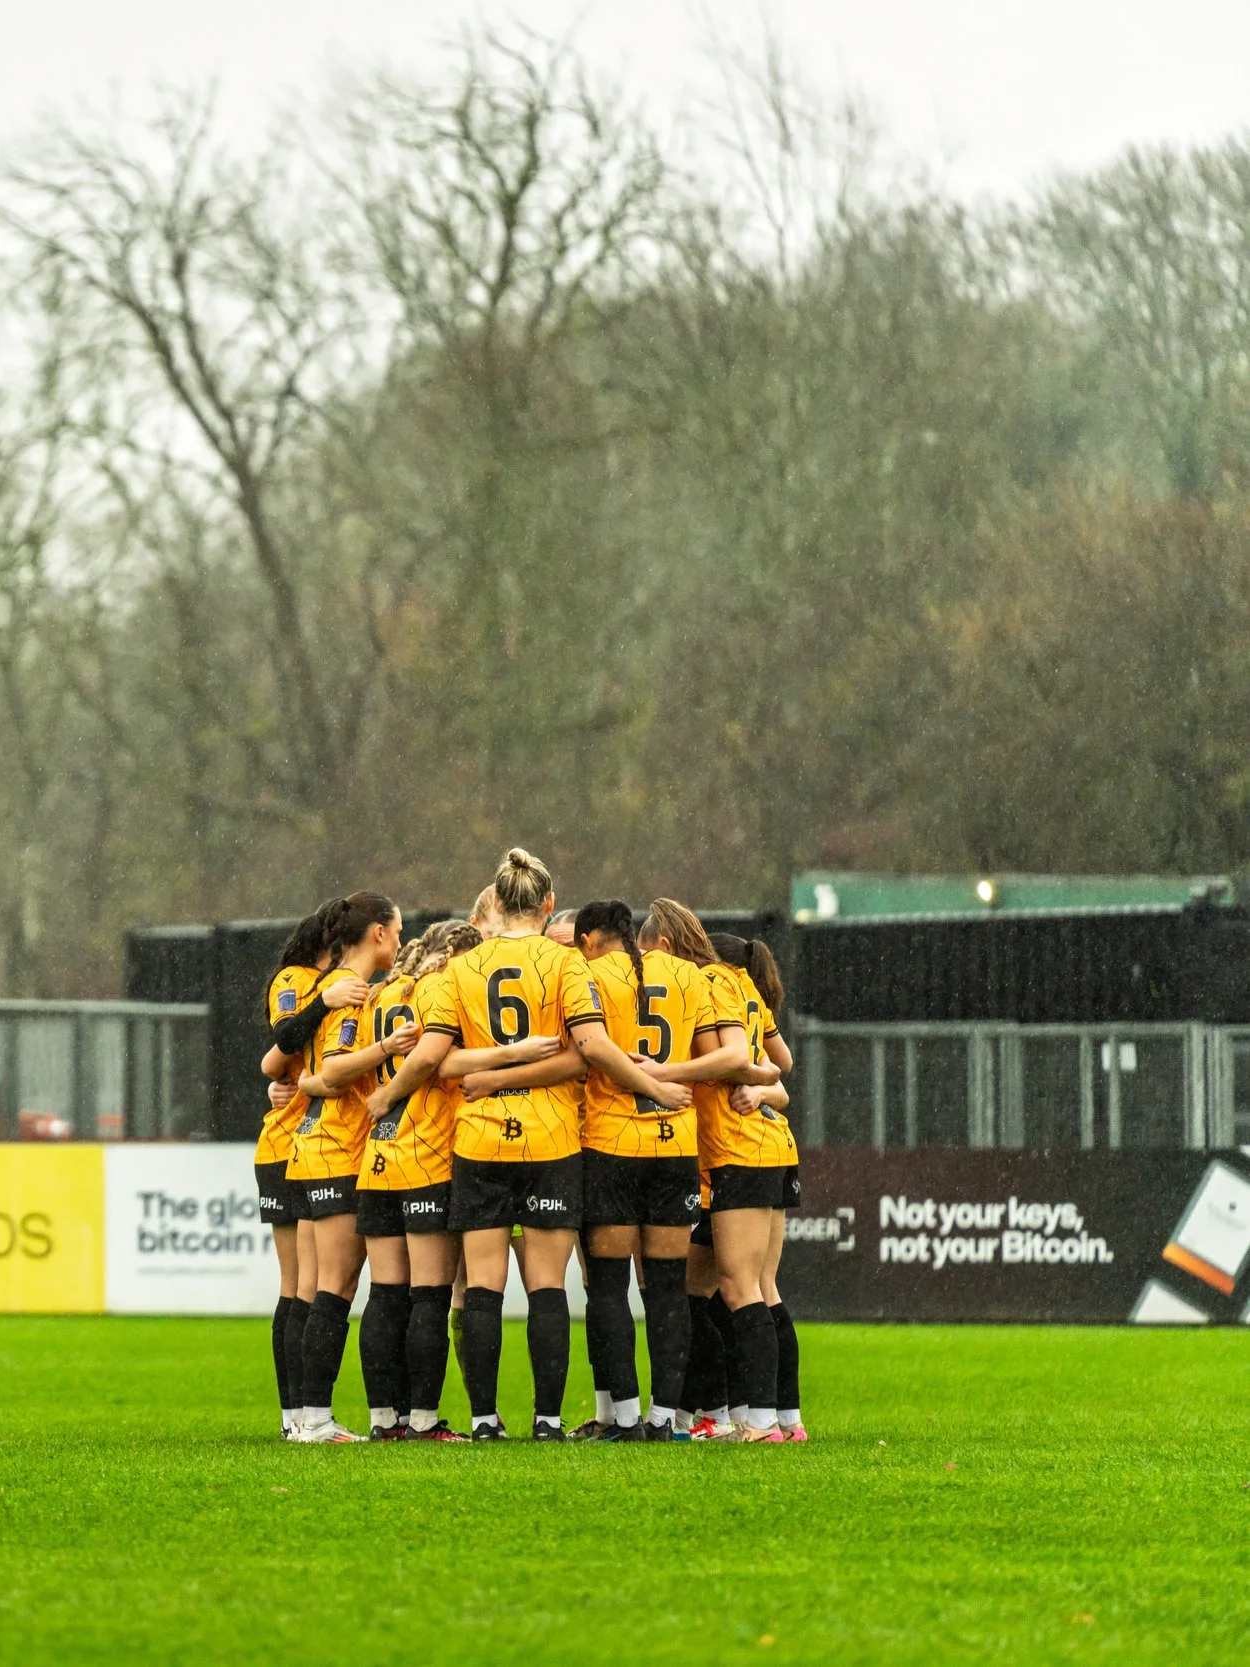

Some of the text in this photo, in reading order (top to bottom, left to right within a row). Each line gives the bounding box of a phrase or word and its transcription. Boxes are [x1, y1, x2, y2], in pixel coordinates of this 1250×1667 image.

[486, 966, 531, 1046] 6
[636, 984, 673, 1065] 5
[378, 1121, 400, 1133] STON
[260, 1196, 277, 1210] PJH
[311, 1187, 335, 1202] PJH
[410, 1201, 436, 1214] PJH
[540, 1199, 563, 1210] PJH
[136, 1190, 258, 1228] The glo
[879, 1195, 1085, 1236] Not your keys,
[137, 1224, 254, 1254] bitcoin
[784, 1217, 841, 1241] EDGER
[879, 1230, 1116, 1271] not your Bitcoin.
